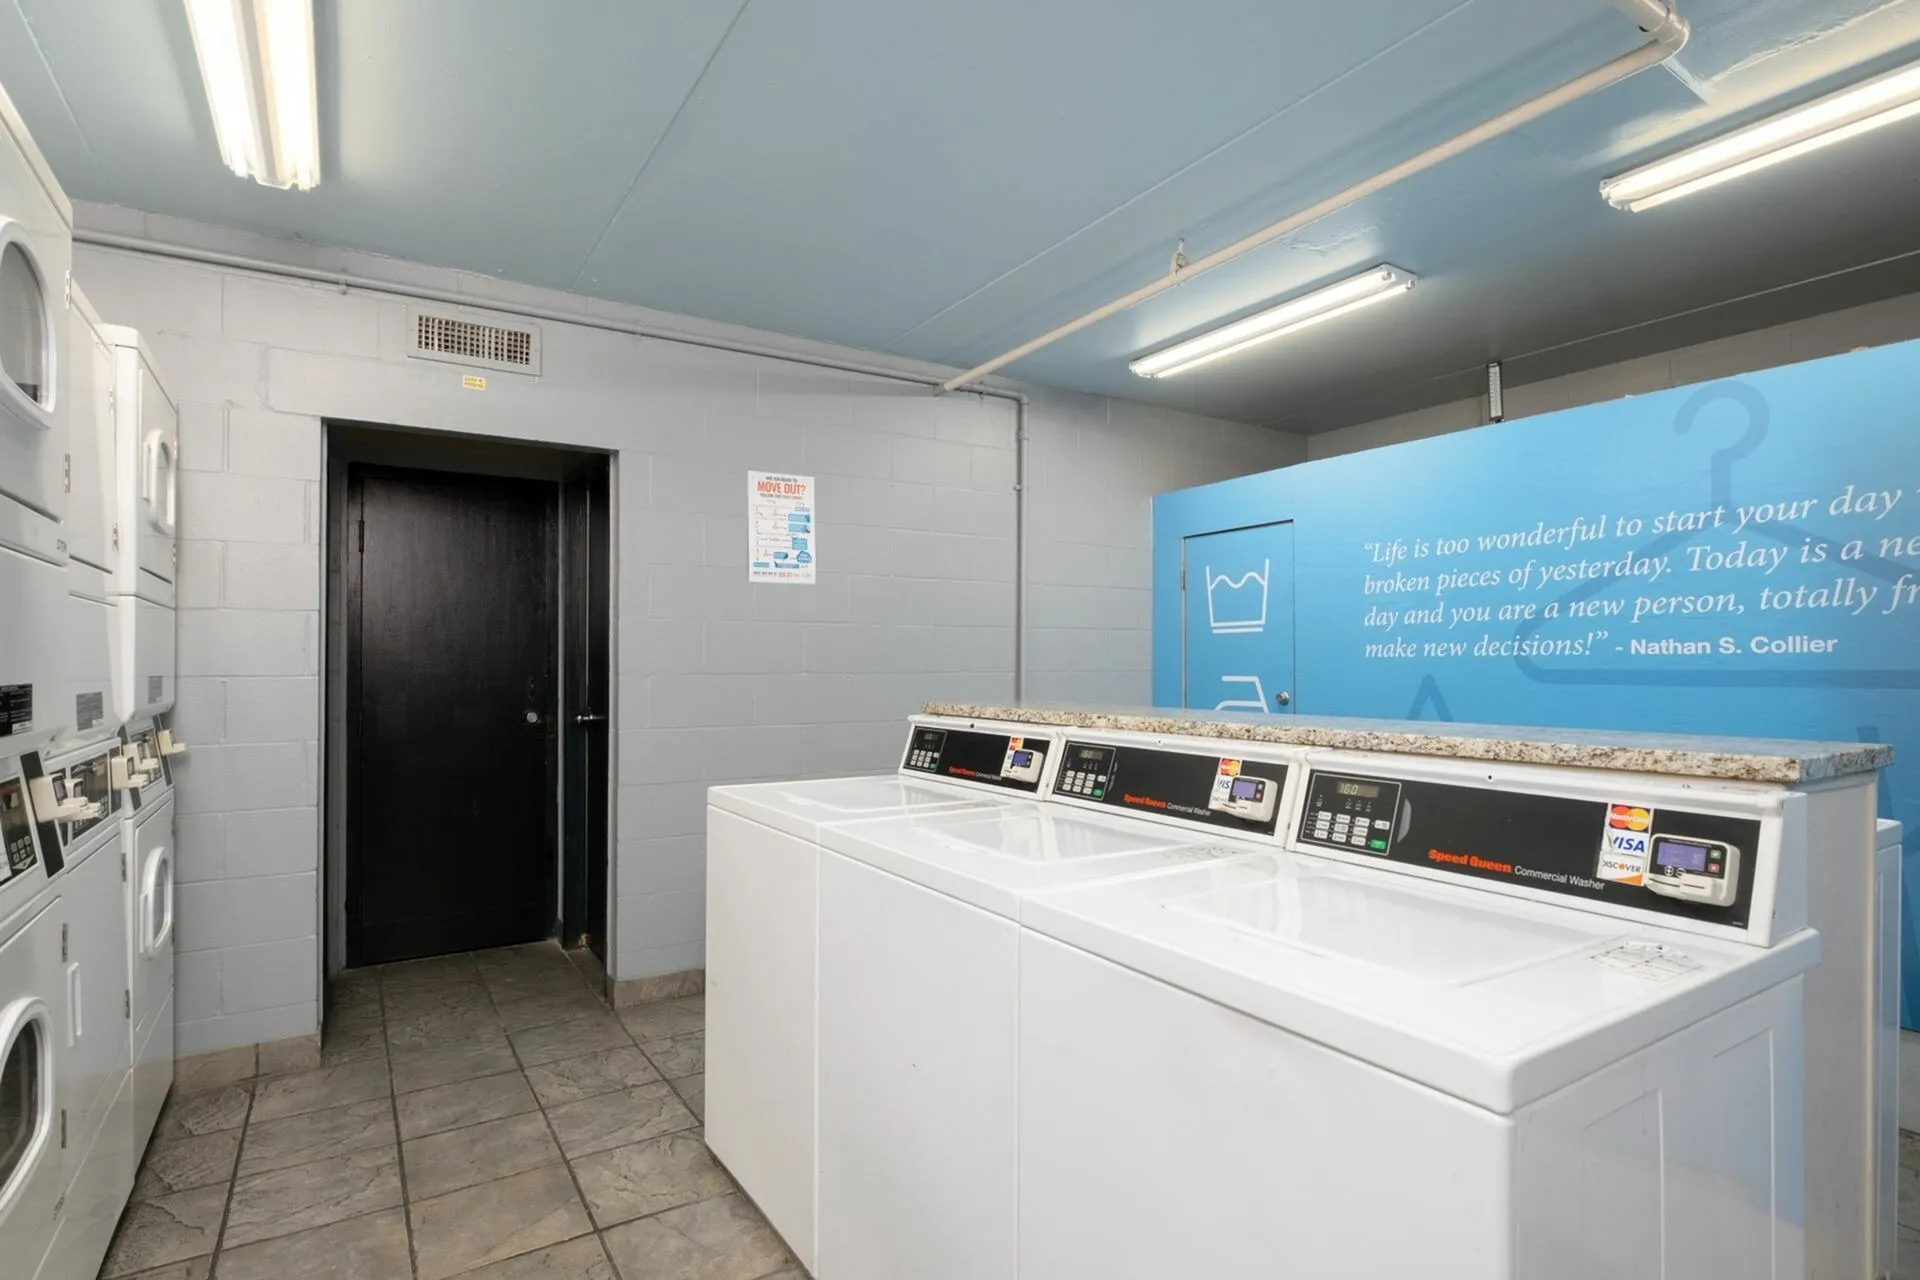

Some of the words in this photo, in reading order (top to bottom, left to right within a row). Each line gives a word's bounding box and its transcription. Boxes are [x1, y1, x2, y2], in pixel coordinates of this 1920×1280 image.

[757, 480, 782, 494] MOVE
[783, 483, 807, 496] OUT?
[1414, 538, 1430, 558] is
[1436, 537, 1470, 556] too
[1478, 513, 1607, 550] wonderful
[1616, 516, 1642, 538] to
[1652, 505, 1726, 534] start
[1731, 499, 1818, 535] your
[1829, 484, 1903, 521] day
[1364, 572, 1430, 595] broken
[1434, 568, 1502, 597] pieces
[1508, 559, 1537, 592] of
[1535, 551, 1672, 590] yesterday.
[1686, 540, 1788, 576] Today
[1800, 537, 1828, 564] is
[1840, 540, 1864, 561] a
[1364, 605, 1399, 632] day
[1404, 601, 1444, 625] and
[1448, 605, 1491, 630] you
[1498, 603, 1536, 621] are
[1544, 601, 1560, 619] a
[1569, 599, 1625, 618] new
[1630, 591, 1745, 624] person,
[1760, 577, 1878, 616] totally
[1365, 637, 1417, 658] make
[1423, 641, 1468, 657] new
[1630, 639, 1712, 656] Nathan
[1718, 636, 1743, 655] S.
[1750, 635, 1838, 654] Collier
[1166, 802, 1194, 814] Commercial
[1428, 849, 1468, 865] Speed
[1469, 855, 1513, 873] Queen
[1514, 865, 1568, 884] Commercial
[1569, 875, 1606, 890] Washer
